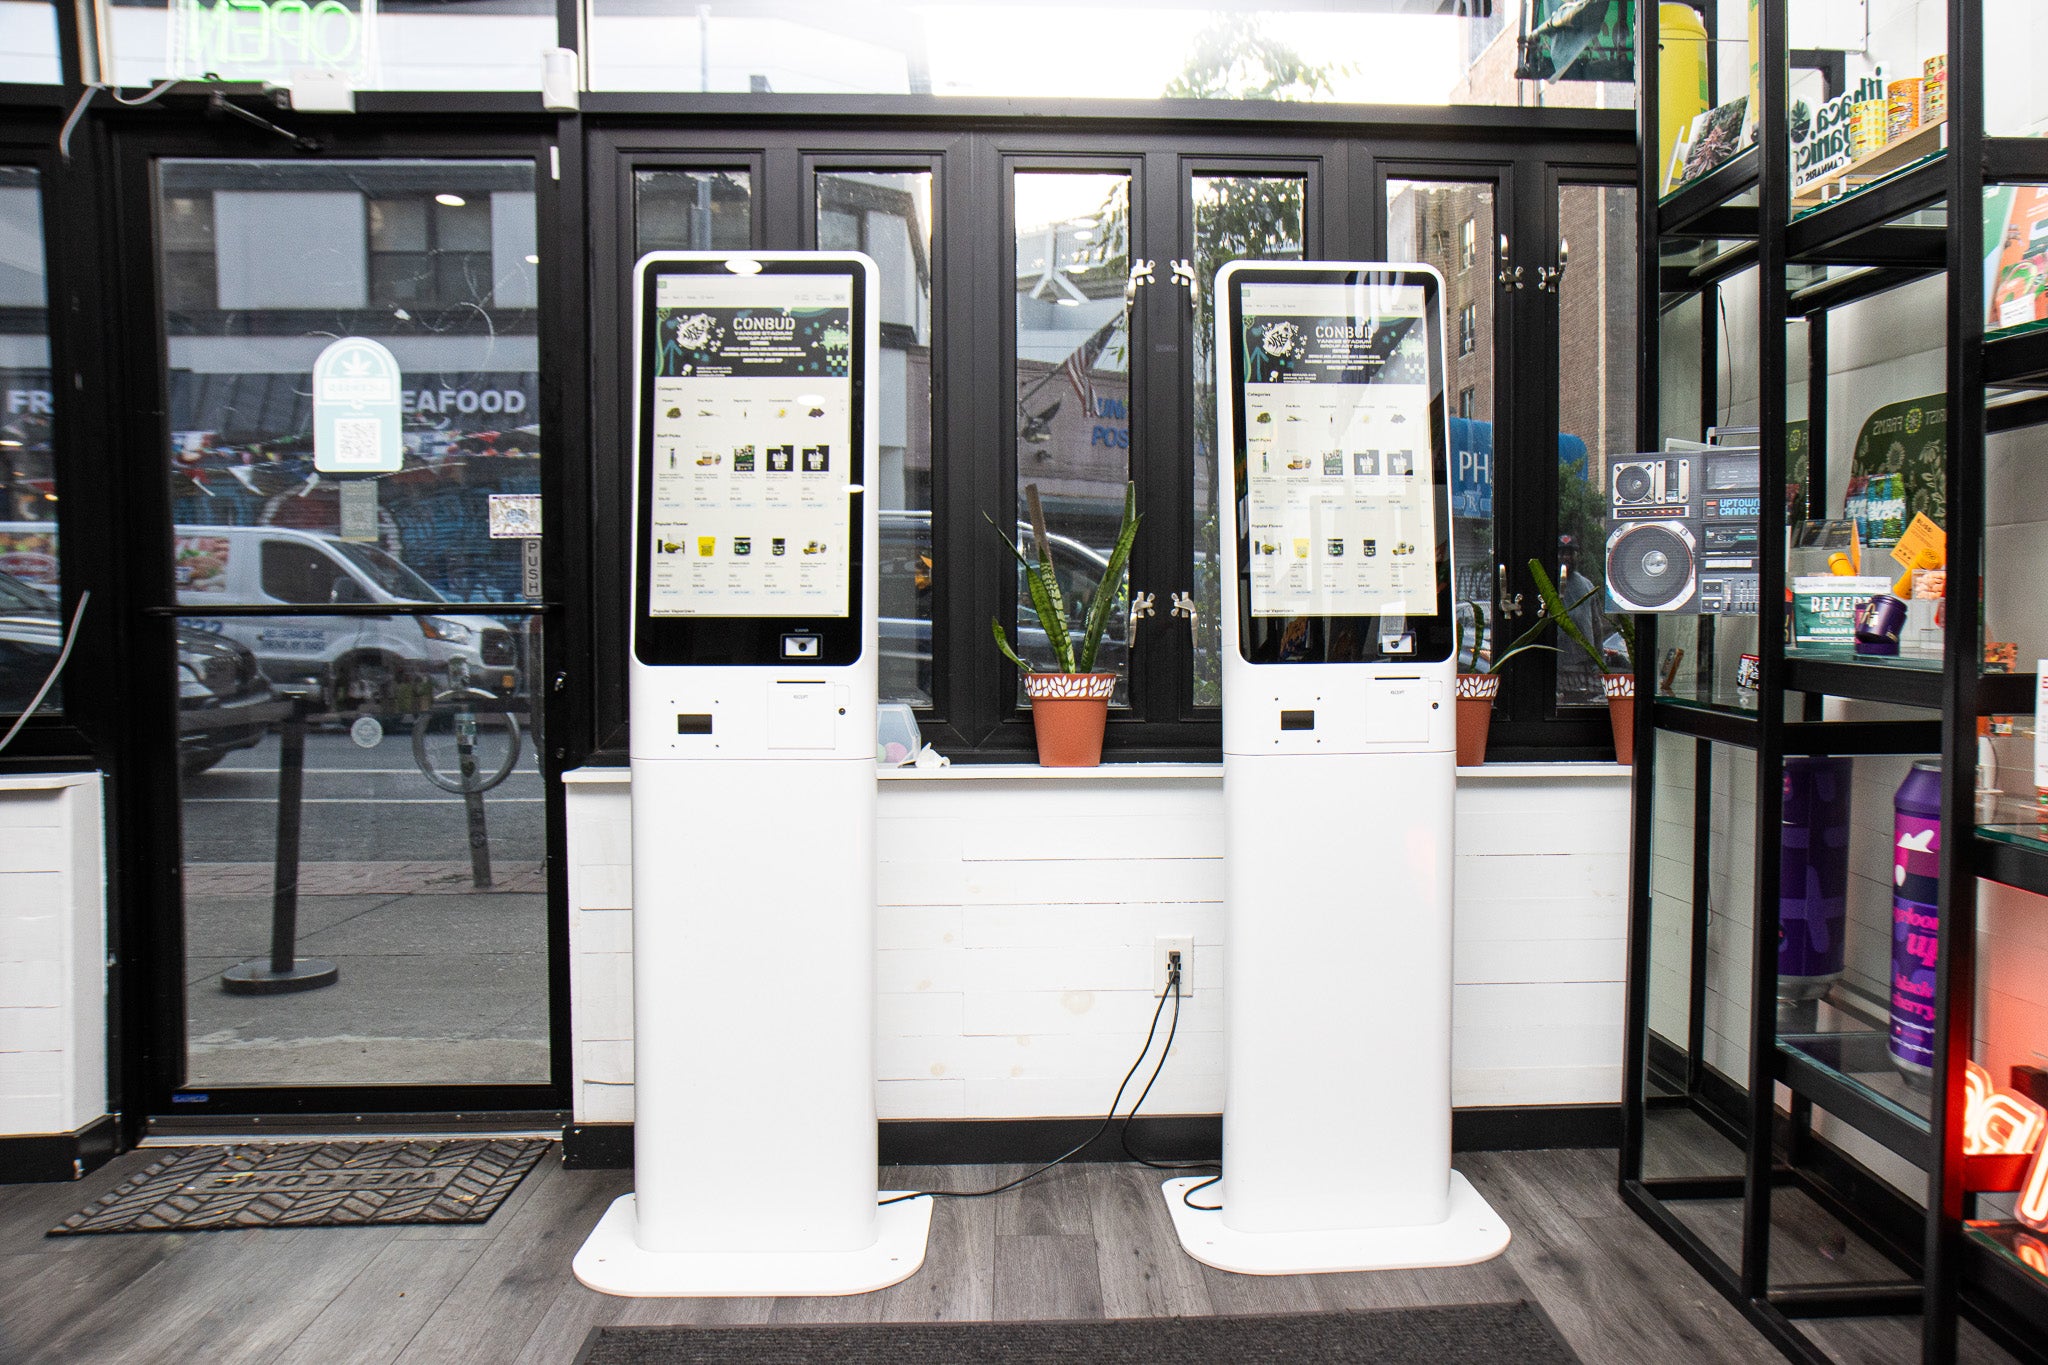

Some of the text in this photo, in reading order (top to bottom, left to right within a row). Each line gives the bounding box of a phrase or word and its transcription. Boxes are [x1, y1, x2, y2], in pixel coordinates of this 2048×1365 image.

[733, 317, 796, 330] CONBUD
[1315, 326, 1373, 338] CONBUD
[401, 389, 526, 413] EAFOOD
[1459, 451, 1493, 485] PH
[1720, 497, 1760, 508] UPTOWN
[1720, 506, 1748, 516] CANNA
[528, 542, 538, 593] PUSH
[212, 1171, 439, 1190] WELCOME
